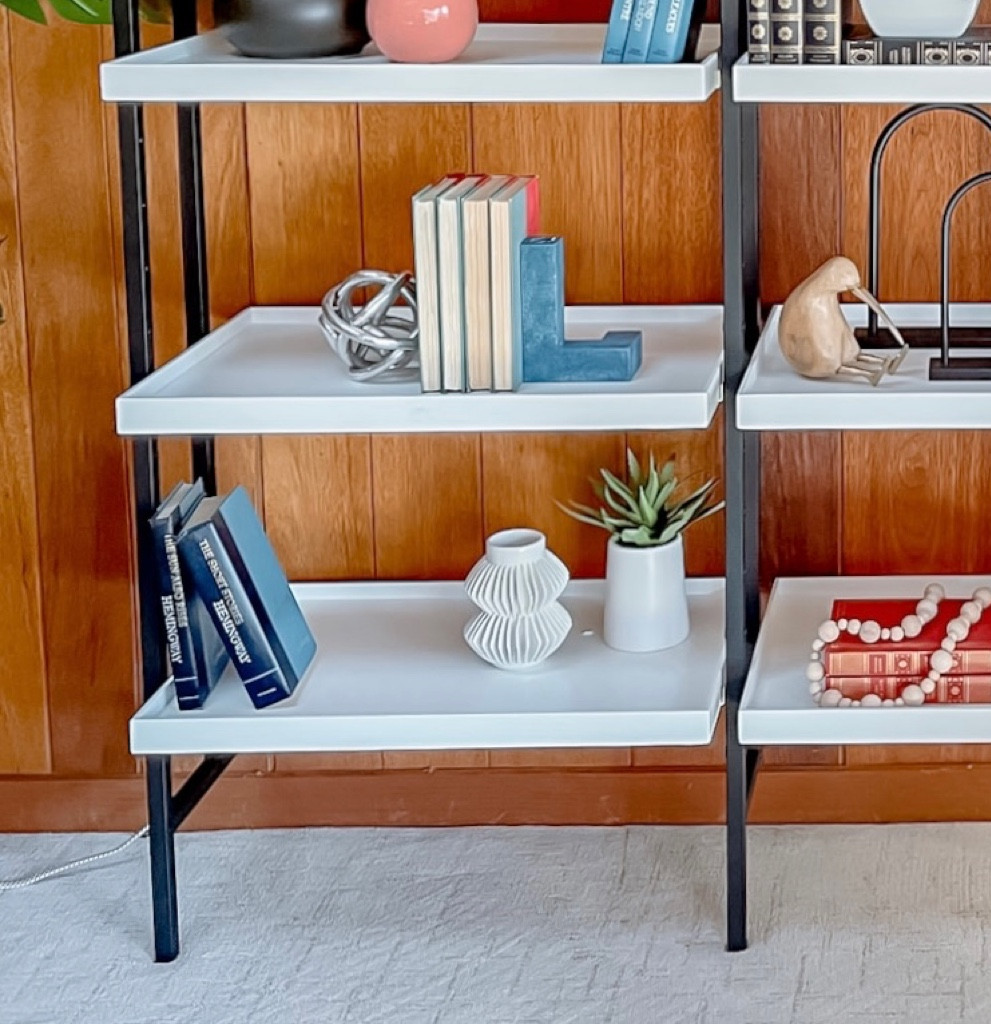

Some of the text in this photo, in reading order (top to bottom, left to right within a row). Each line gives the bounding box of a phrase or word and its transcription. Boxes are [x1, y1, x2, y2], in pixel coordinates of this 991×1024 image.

[199, 538, 244, 626] THE SHORT STORIES
[161, 595, 183, 663] HEMINGWAY
[213, 599, 252, 664] HEMINGWAY
